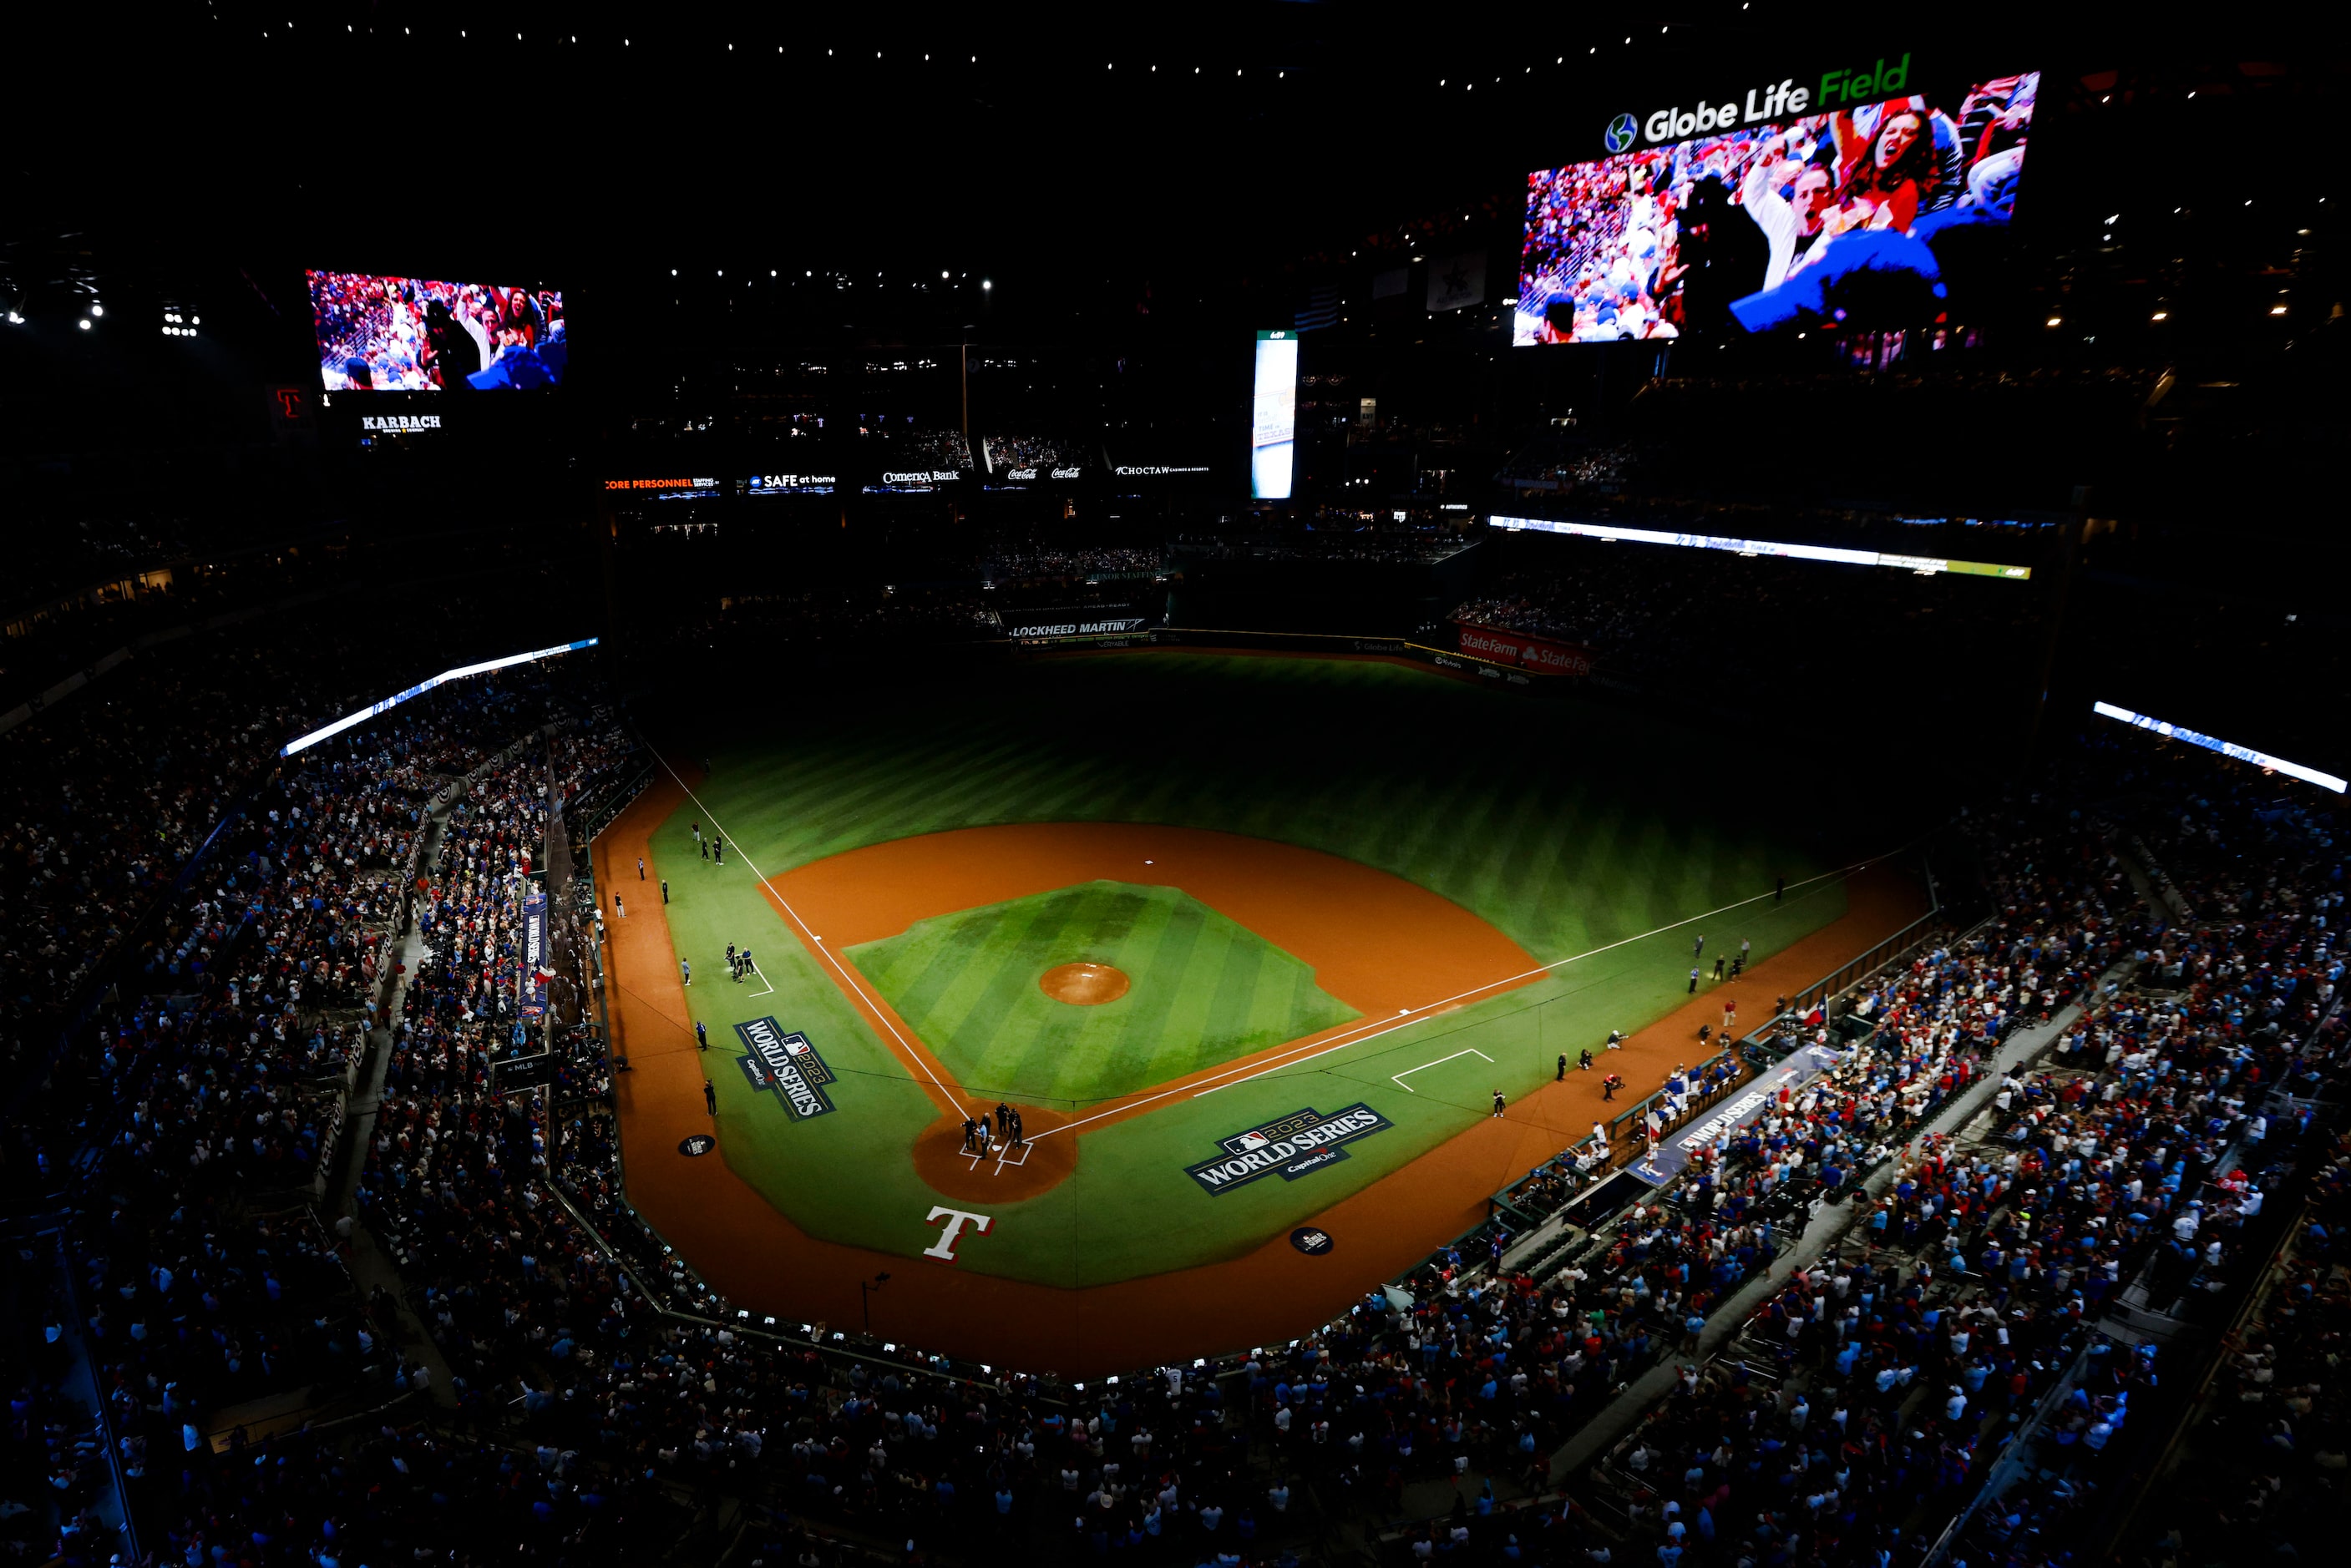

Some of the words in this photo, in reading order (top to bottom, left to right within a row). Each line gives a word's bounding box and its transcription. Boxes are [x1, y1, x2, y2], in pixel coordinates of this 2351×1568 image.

[1644, 99, 1737, 143] Globe
[1744, 78, 1810, 124] Life
[1818, 53, 1911, 108] Field
[362, 415, 441, 429] KARBACH
[933, 469, 960, 481] Bank
[1120, 465, 1169, 475] CHOCTAW
[633, 478, 693, 488] PERSONNEL
[764, 475, 798, 487] SAFE
[1013, 625, 1076, 637] LOCKHEED
[1079, 622, 1126, 635] MARTIN
[1364, 643, 1387, 651] Globe
[514, 1062, 534, 1071] MLB
[747, 1020, 789, 1067] WORLD
[774, 1065, 822, 1116] SERIES
[798, 1054, 826, 1084] 2023
[1724, 1091, 1766, 1120] SERIES
[1264, 1114, 1320, 1139] 2023
[1197, 1142, 1295, 1186] WORLD
[1291, 1109, 1378, 1151] SERIES
[923, 1206, 996, 1264] T
